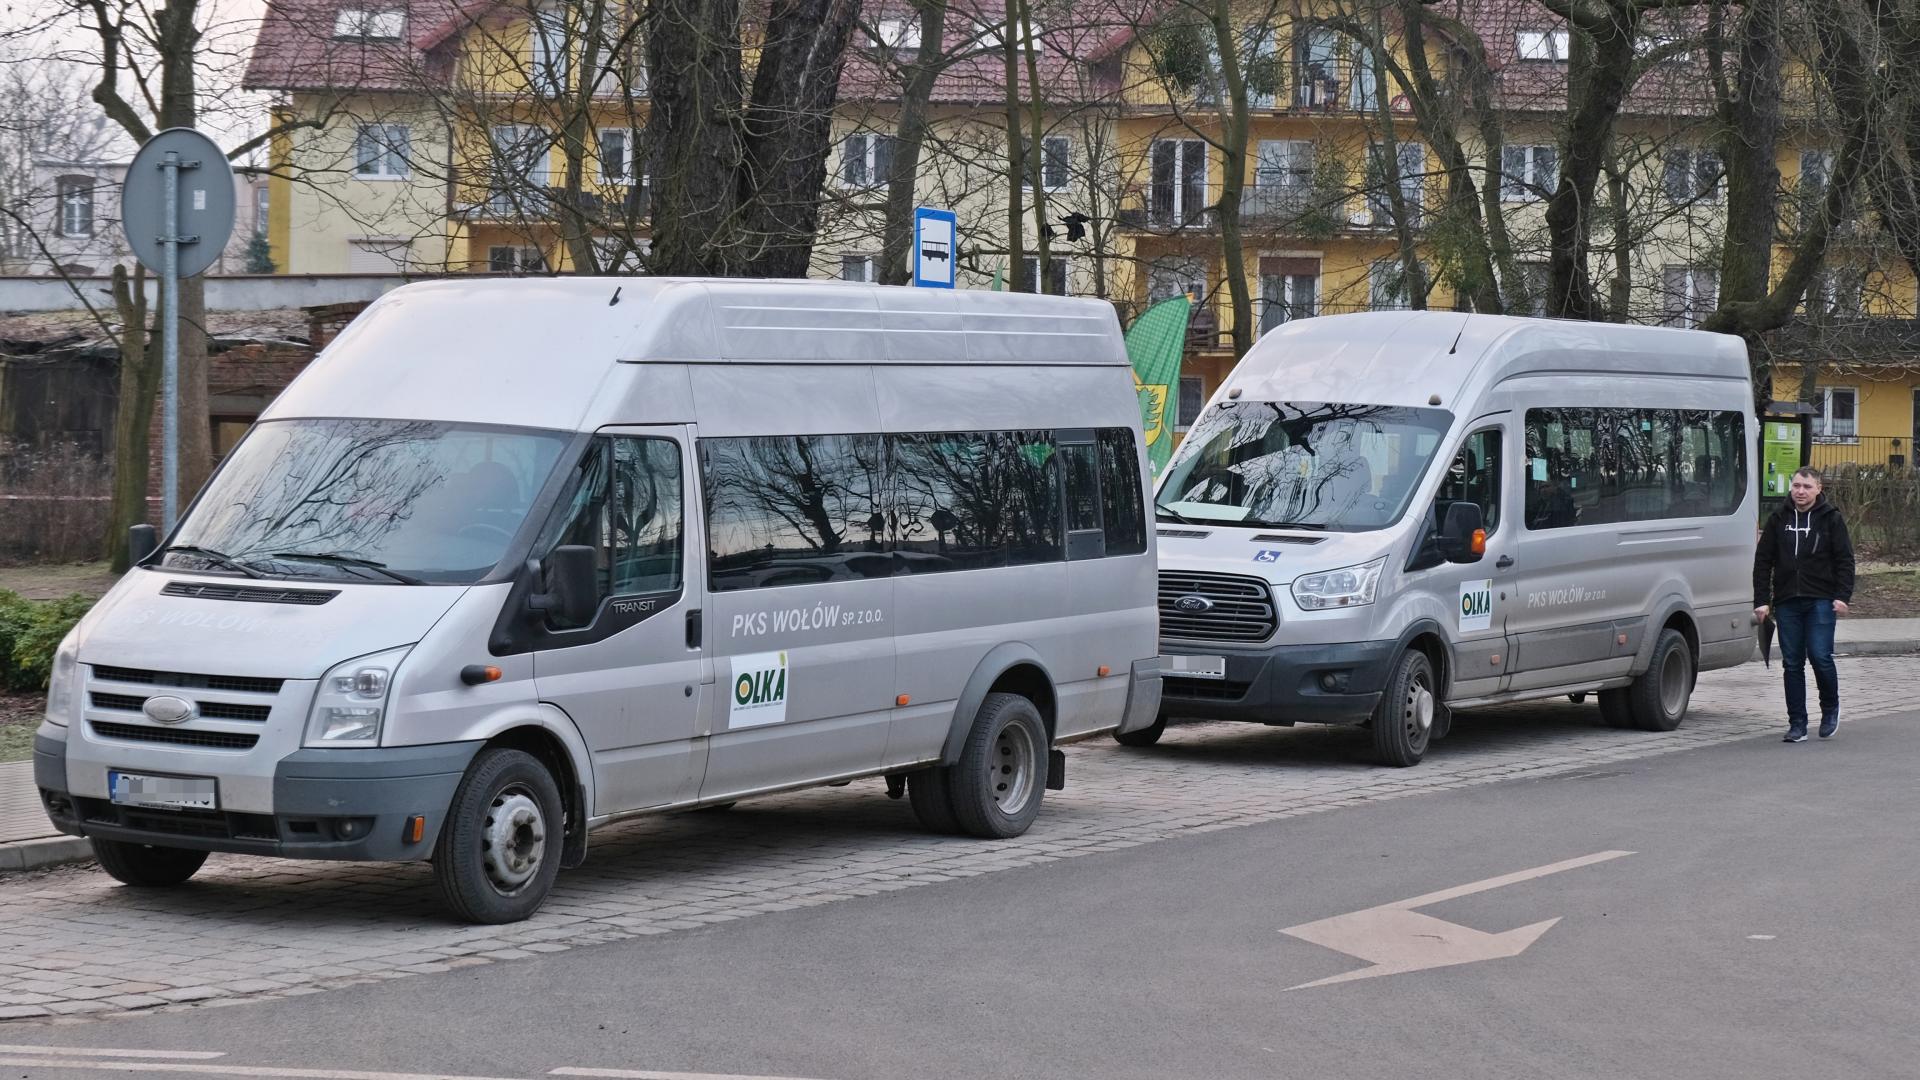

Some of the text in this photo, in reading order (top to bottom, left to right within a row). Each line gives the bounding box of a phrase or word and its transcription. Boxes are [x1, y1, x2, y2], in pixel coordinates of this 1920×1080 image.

[613, 600, 656, 613] TRANSIT
[1181, 598, 1200, 609] Ford
[1462, 590, 1490, 616] OLKA
[1527, 591, 1547, 608] PKS
[731, 611, 768, 638] PKS
[773, 600, 841, 633] WOŁÓW
[841, 611, 855, 626] SP.
[857, 610, 864, 624] Z
[735, 668, 786, 706] OLKA
